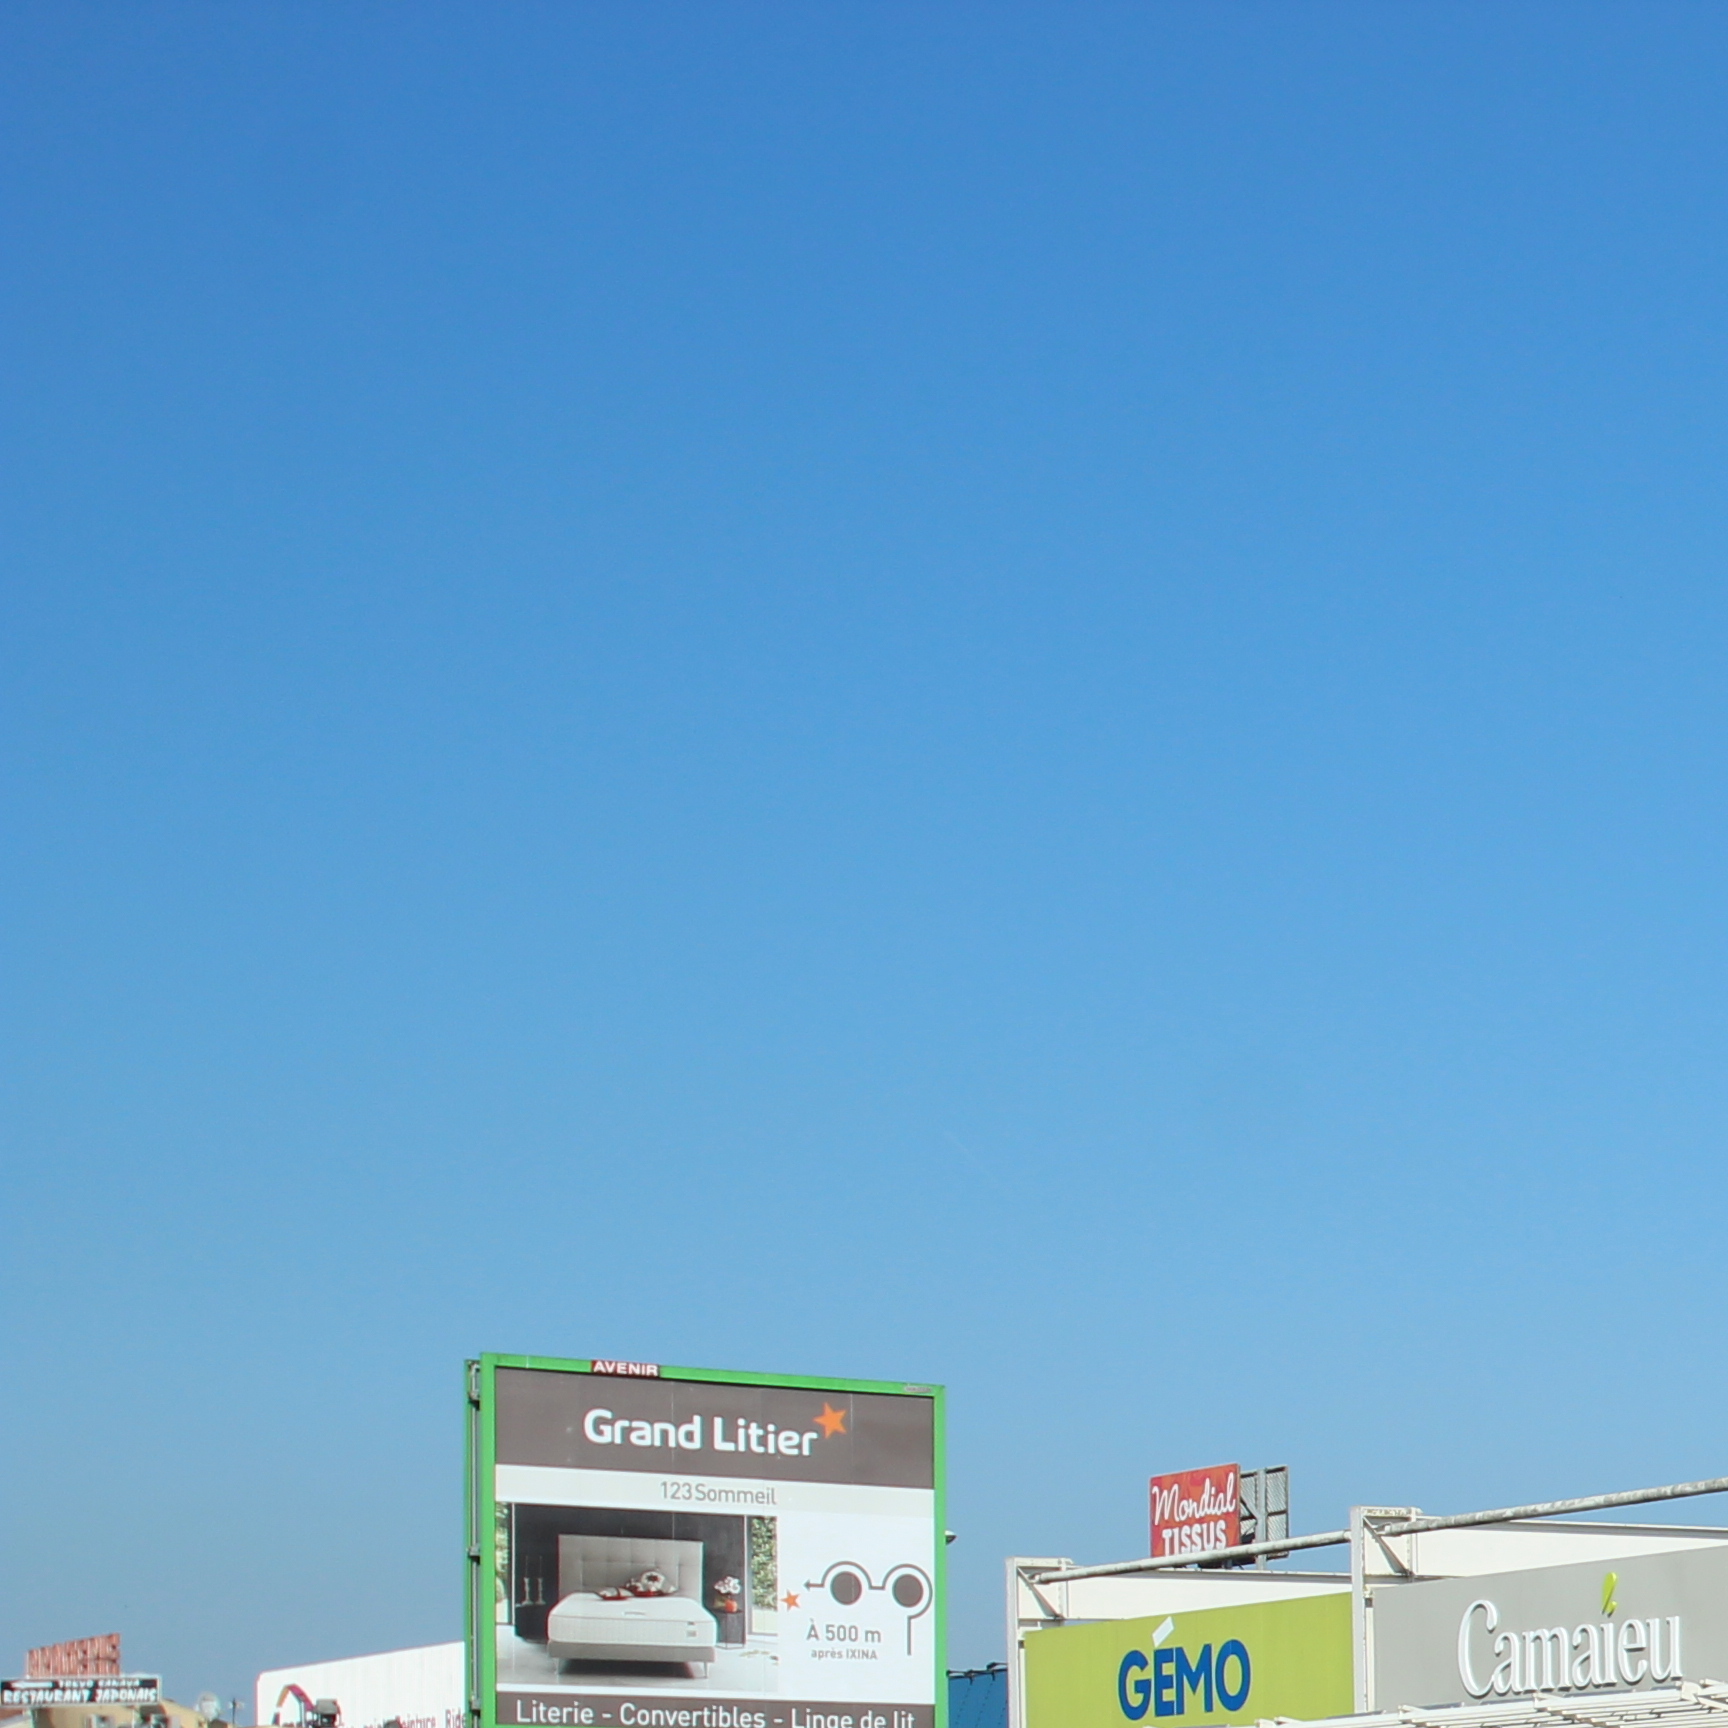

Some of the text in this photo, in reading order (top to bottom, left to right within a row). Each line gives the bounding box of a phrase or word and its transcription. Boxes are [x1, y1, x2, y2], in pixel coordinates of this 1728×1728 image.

[592, 1360, 659, 1377] AVENIR
[583, 1408, 819, 1457] Grand Litier
[1152, 1471, 1236, 1526] Mondial
[1161, 1519, 1227, 1557] TISSUS
[806, 1618, 882, 1643] À 500 m
[810, 1648, 878, 1662] après IXINA
[3, 1687, 157, 1704] RESTAURANT JAPONAIS
[516, 1699, 594, 1725] Literie
[619, 1702, 766, 1728] Convertibles
